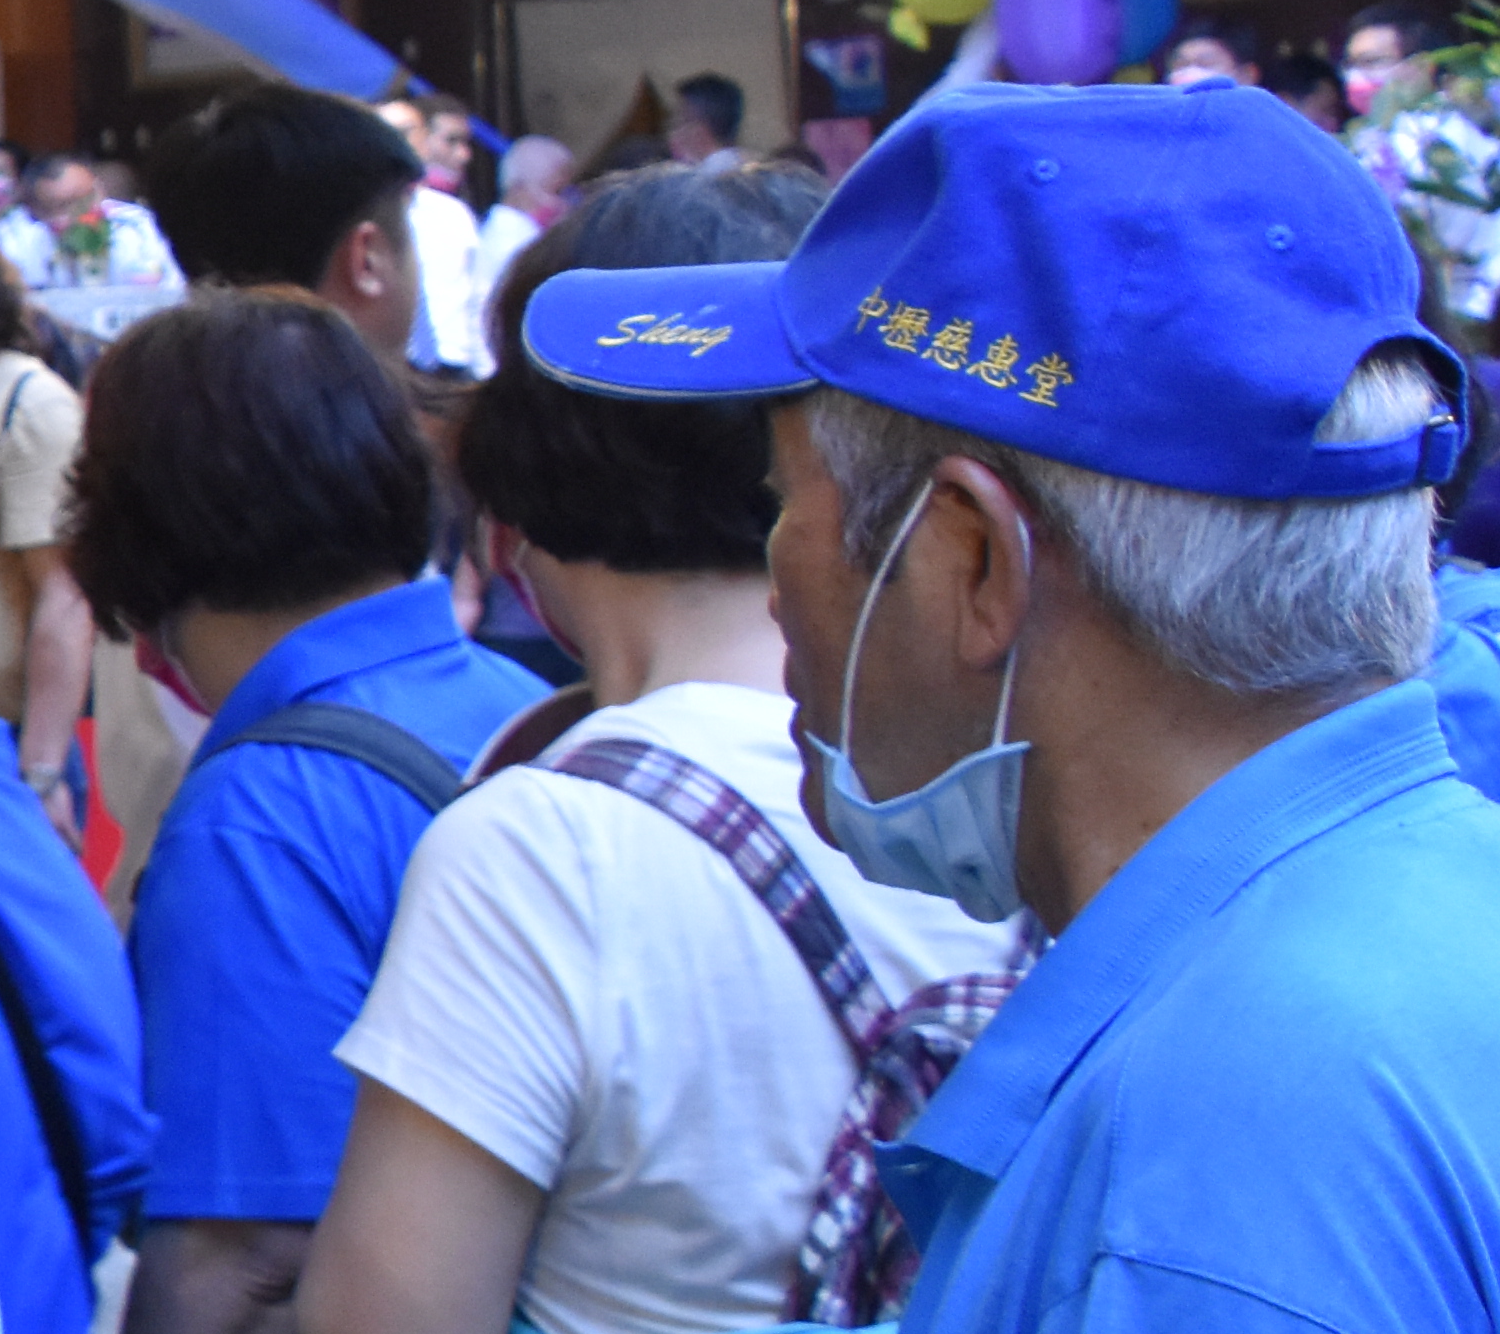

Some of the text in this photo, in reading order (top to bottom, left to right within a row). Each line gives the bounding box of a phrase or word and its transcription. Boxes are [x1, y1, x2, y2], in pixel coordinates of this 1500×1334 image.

[597, 312, 735, 358] Sheng
[857, 286, 1073, 408] 中壢慈惠堂
